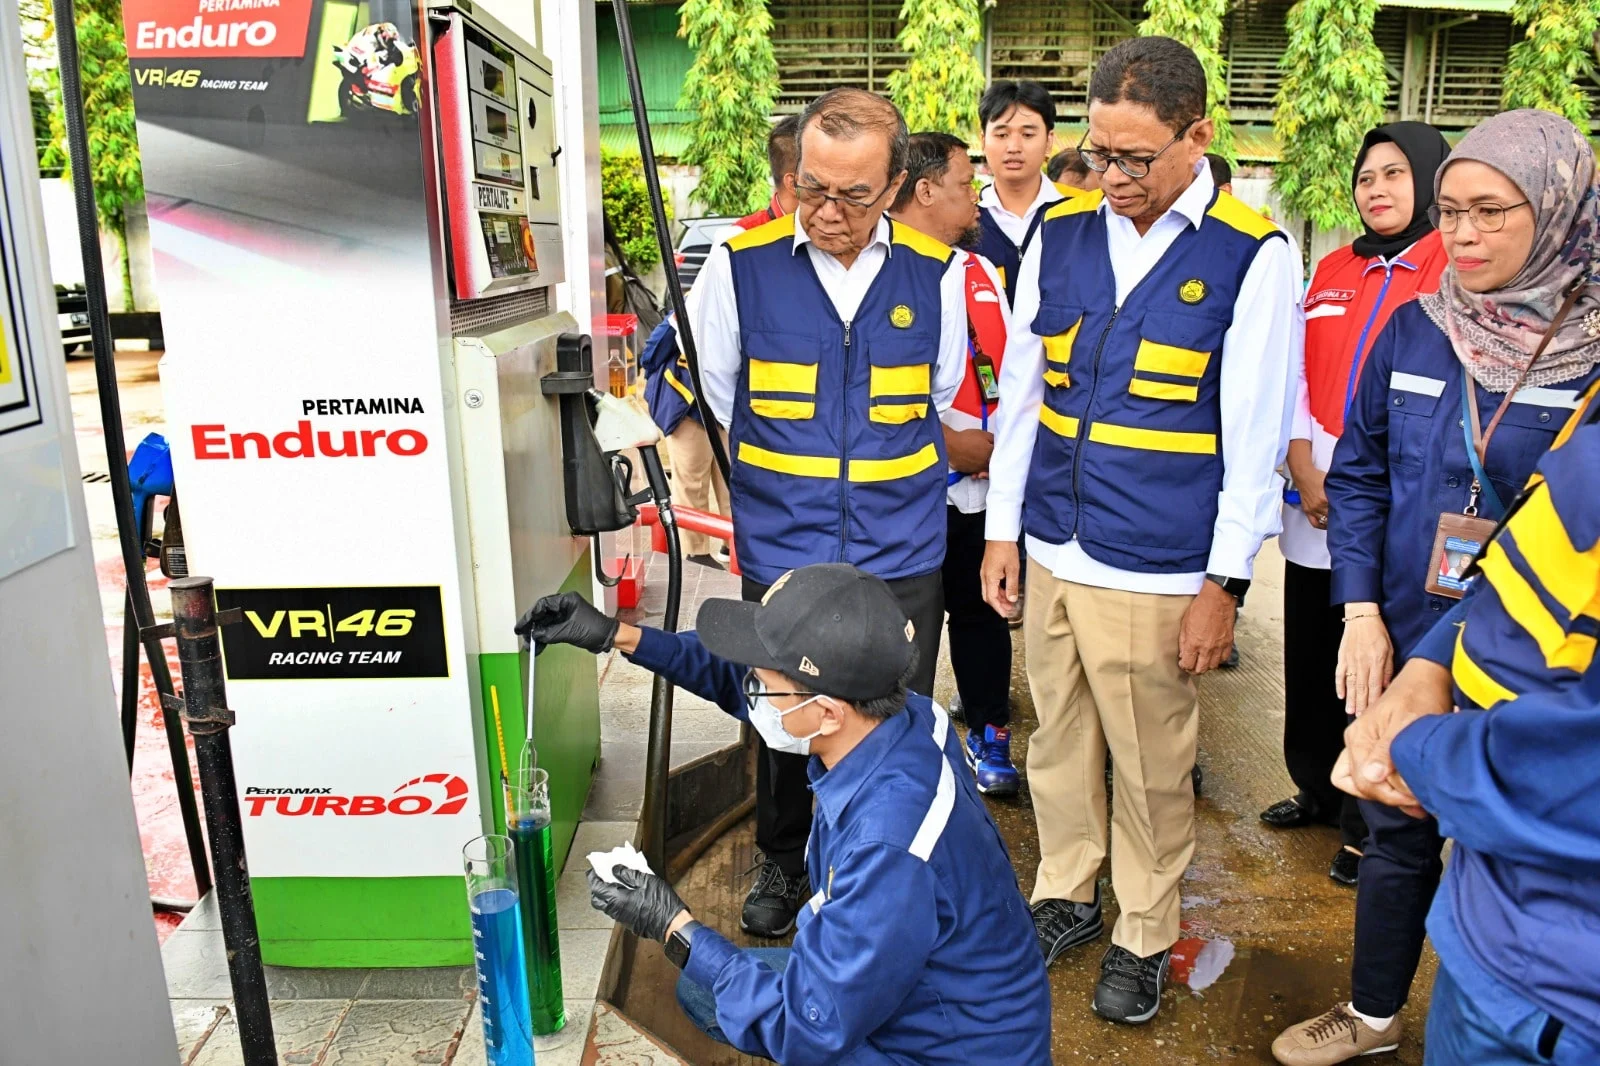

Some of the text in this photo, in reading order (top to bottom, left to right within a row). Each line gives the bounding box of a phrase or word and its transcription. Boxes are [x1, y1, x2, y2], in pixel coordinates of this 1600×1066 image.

[199, 0, 280, 13] PERTAMINA
[136, 16, 277, 49] Enduro
[200, 79, 236, 90] RACING
[238, 80, 268, 91] TEAM
[478, 186, 510, 210] PERTALITE
[302, 397, 425, 416] PERTAMINA
[190, 420, 428, 460] Enduro
[268, 651, 402, 665] RACING TEAM
[244, 796, 432, 816] TURBO
